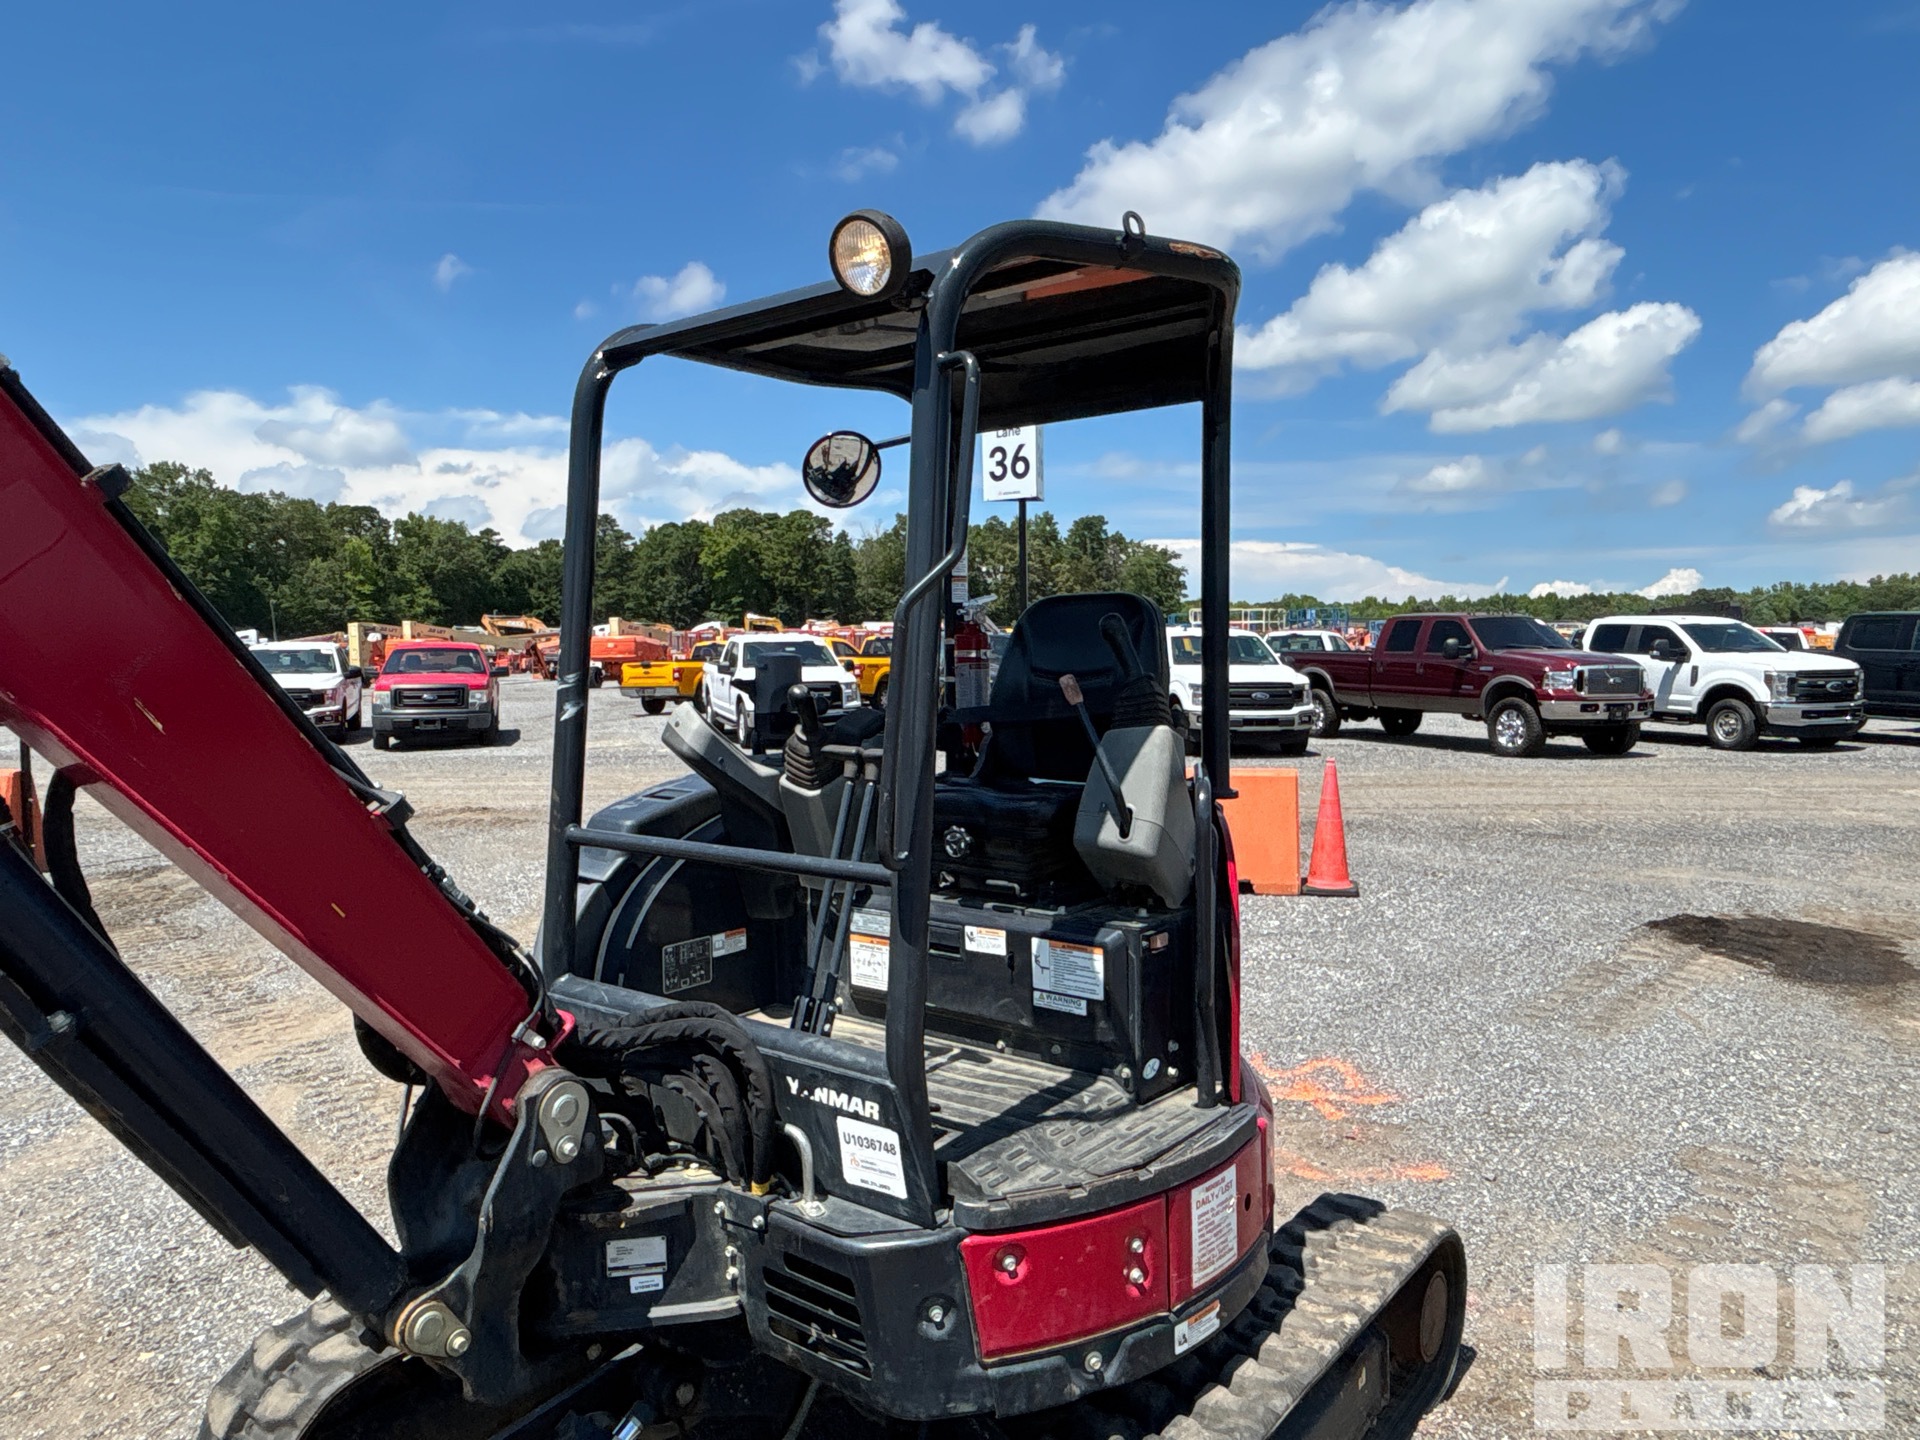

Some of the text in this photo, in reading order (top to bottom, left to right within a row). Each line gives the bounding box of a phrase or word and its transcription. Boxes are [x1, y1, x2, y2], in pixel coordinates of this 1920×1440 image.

[996, 427, 1021, 438] Lane
[989, 443, 1030, 482] 36
[1045, 993, 1082, 1007] WARNING
[785, 1075, 879, 1120] YNMAR
[842, 1131, 897, 1156] U1036748
[1195, 1179, 1234, 1210] DAILY LIST
